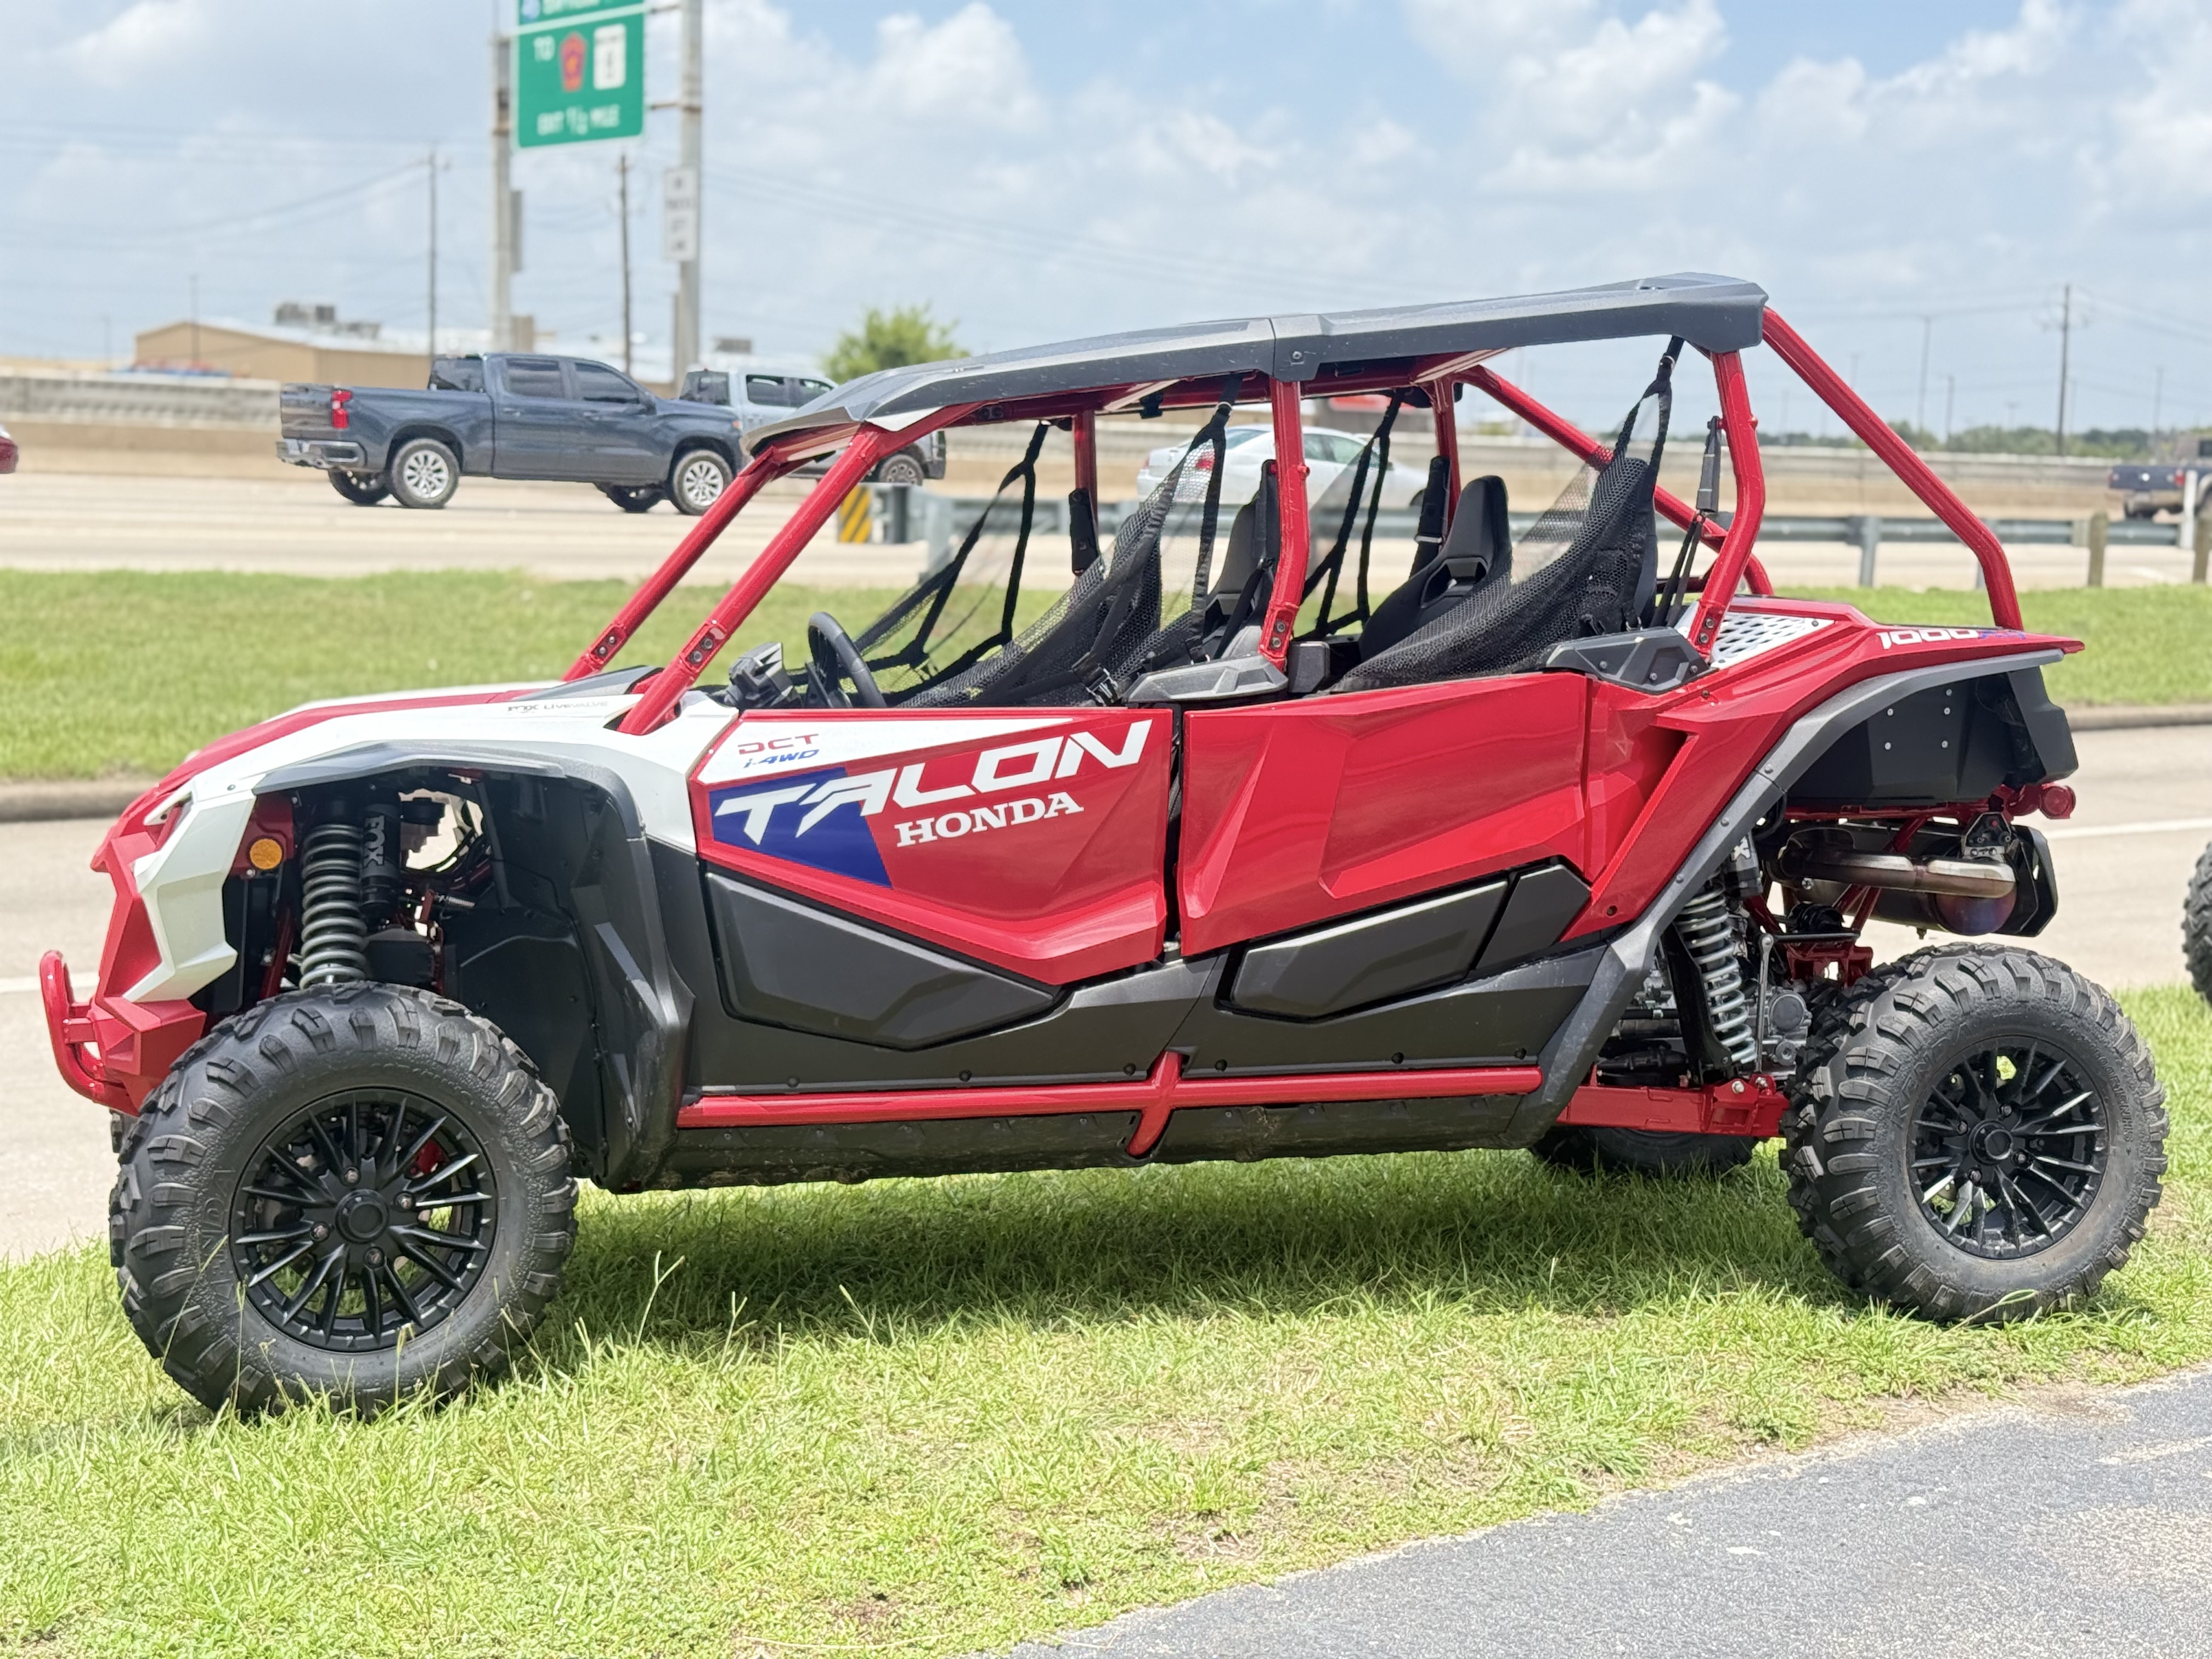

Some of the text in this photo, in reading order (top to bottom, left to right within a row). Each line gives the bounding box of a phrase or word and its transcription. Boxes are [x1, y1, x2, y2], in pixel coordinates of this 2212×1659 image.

[1876, 629, 1979, 650] 1000
[737, 733, 820, 755] DCT
[715, 719, 1153, 845] TALON
[363, 815, 385, 868] FOX
[894, 792, 1084, 848] HONDA
